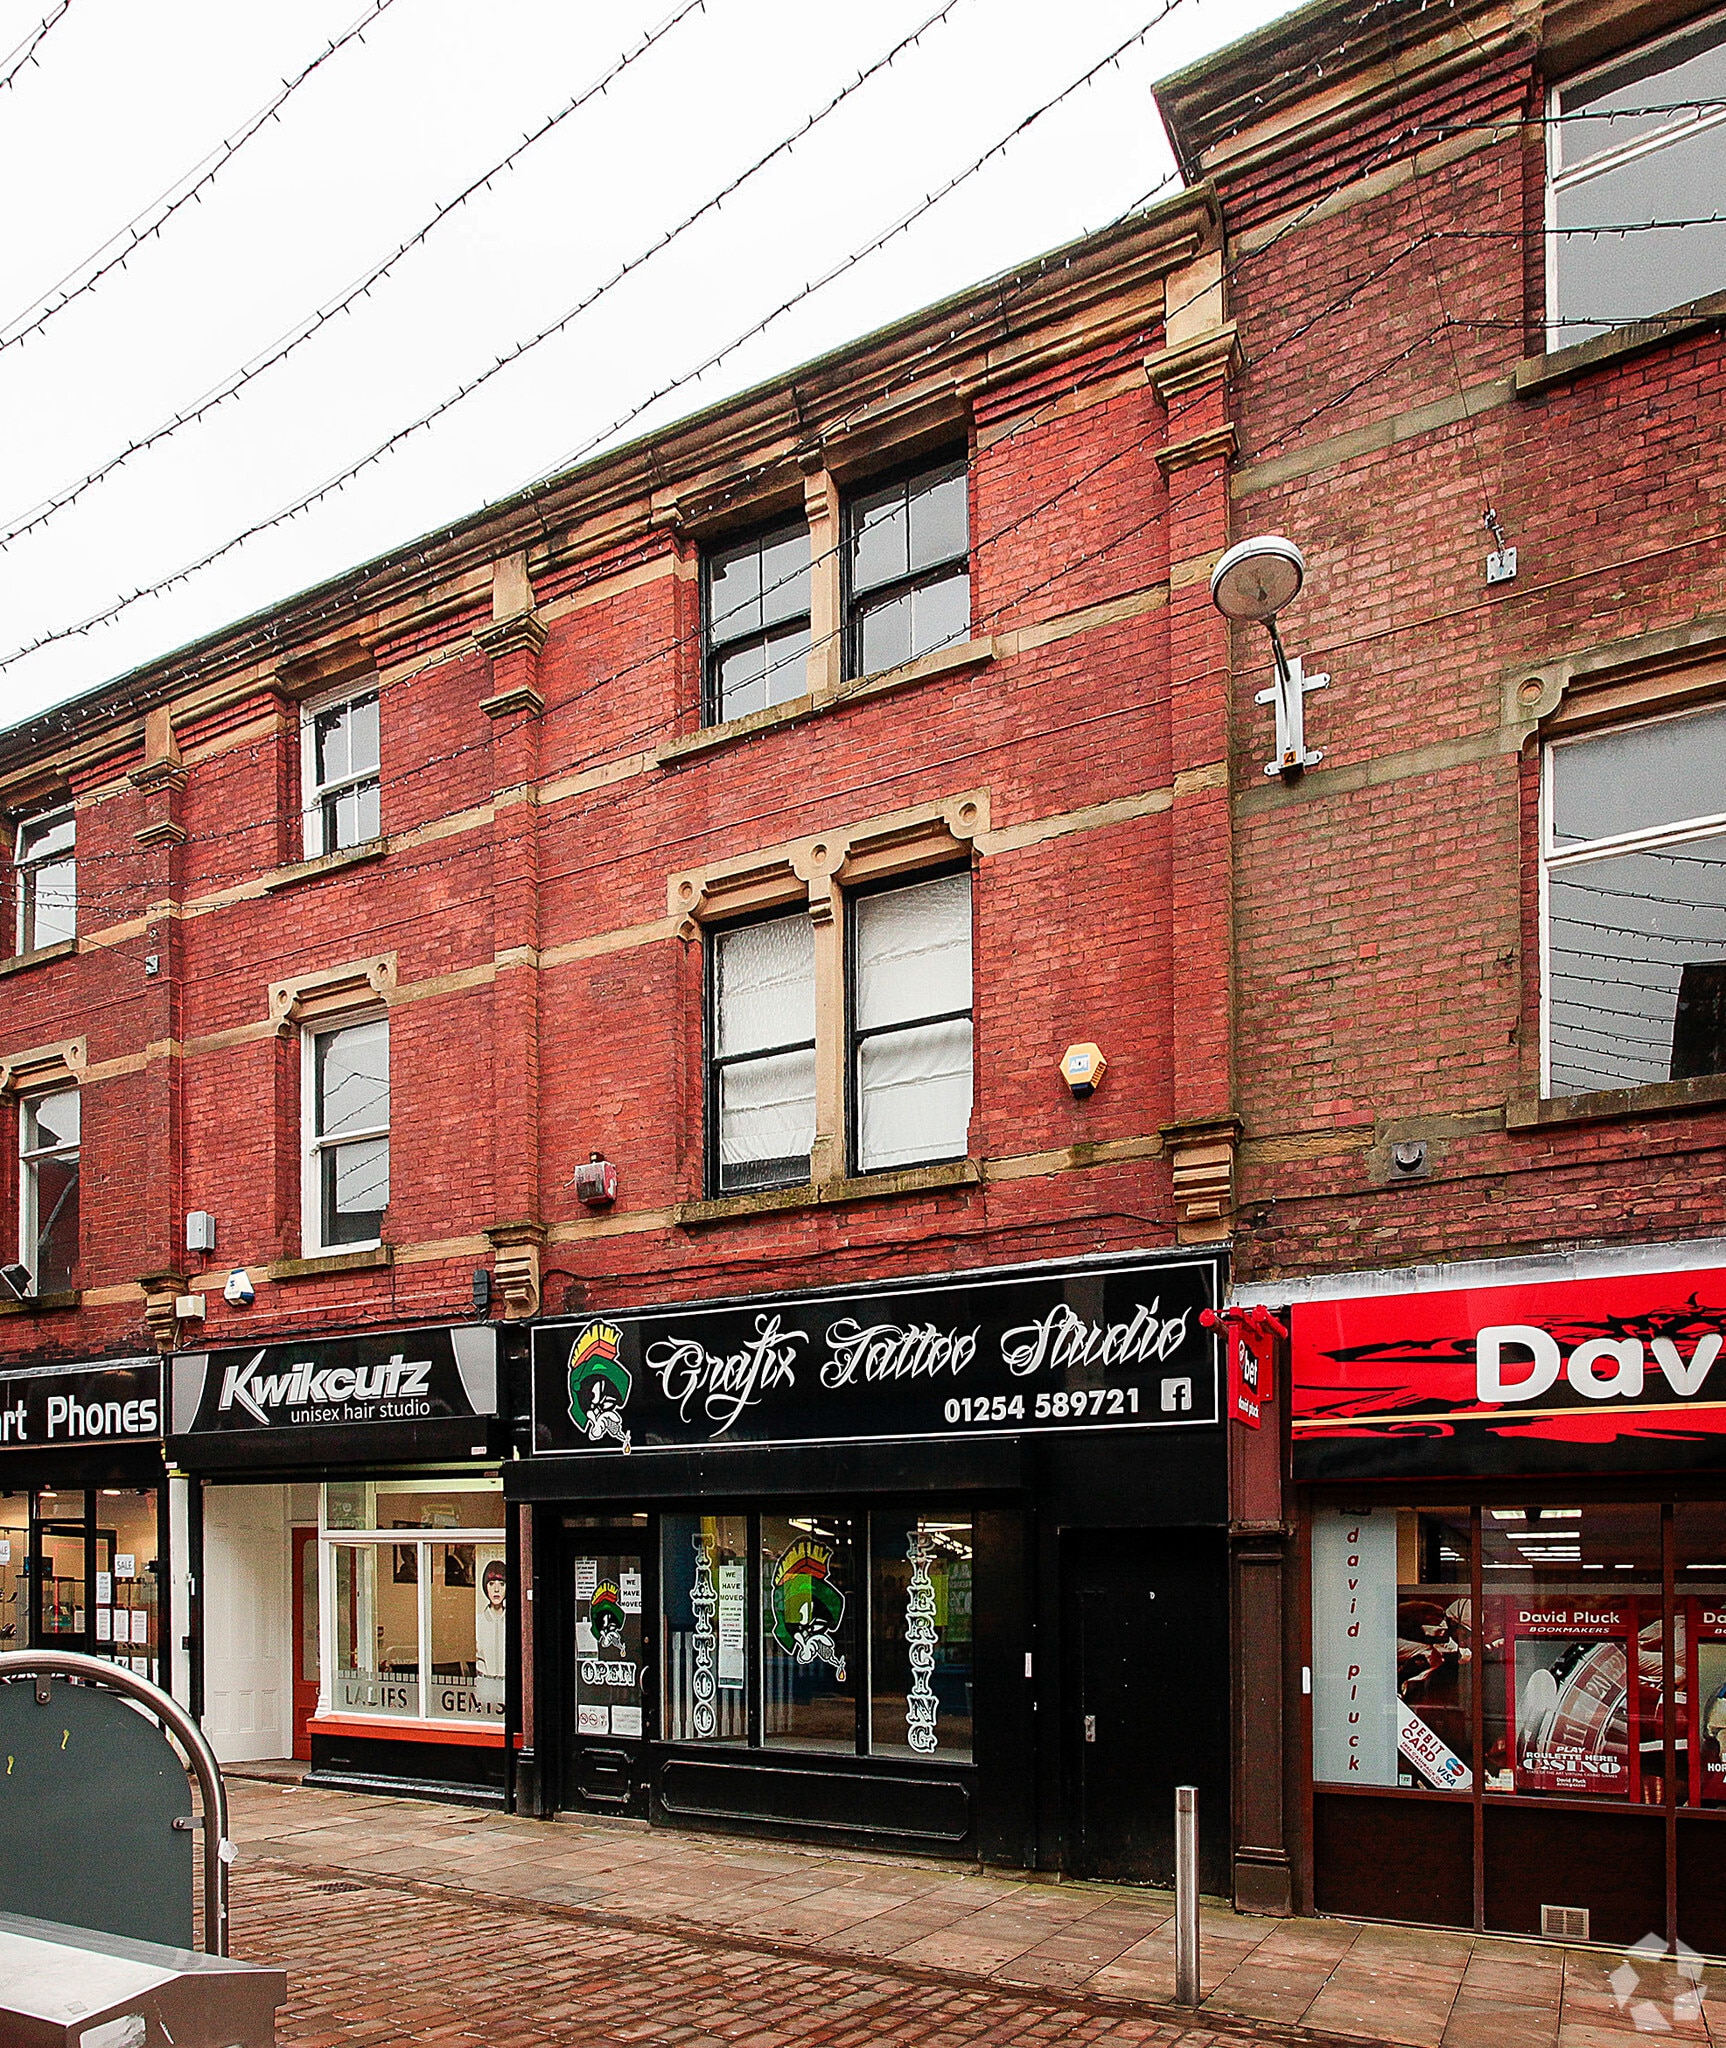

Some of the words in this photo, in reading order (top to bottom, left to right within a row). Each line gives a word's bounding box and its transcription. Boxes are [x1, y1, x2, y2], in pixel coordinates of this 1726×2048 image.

[1285, 752, 1295, 764] 4
[1070, 1058, 1088, 1070] ADT
[646, 1314, 809, 1438] Grafix
[820, 1317, 981, 1388] Tattoo
[1001, 1296, 1192, 1377] Studio
[1244, 1350, 1258, 1386] bet
[1476, 1324, 1724, 1403] Dav
[218, 1348, 433, 1425] Kwikcutz
[291, 1406, 340, 1423] unisex
[344, 1403, 375, 1420] hair
[380, 1399, 430, 1418] studio
[944, 1394, 1025, 1423] 01254
[1034, 1388, 1139, 1419] 589721
[0, 1400, 27, 1440] rt
[116, 1560, 133, 1570] SALE
[1520, 1611, 1566, 1623] David
[1574, 1611, 1620, 1624] Pluck
[1529, 1626, 1610, 1634] BOOKMAKERS
[690, 1533, 718, 1737] TATTOO
[905, 1531, 939, 1753] PIERCING
[581, 1660, 636, 1686] OPEN
[1586, 1674, 1613, 1698] 20
[1401, 1727, 1436, 1763] CARD
[1408, 1718, 1446, 1756] DEBIT
[1526, 1752, 1582, 1760] ROULETTE
[1556, 1746, 1586, 1754] PLAY
[1436, 1766, 1456, 1787] VISA
[1522, 1758, 1622, 1774] CASINO
